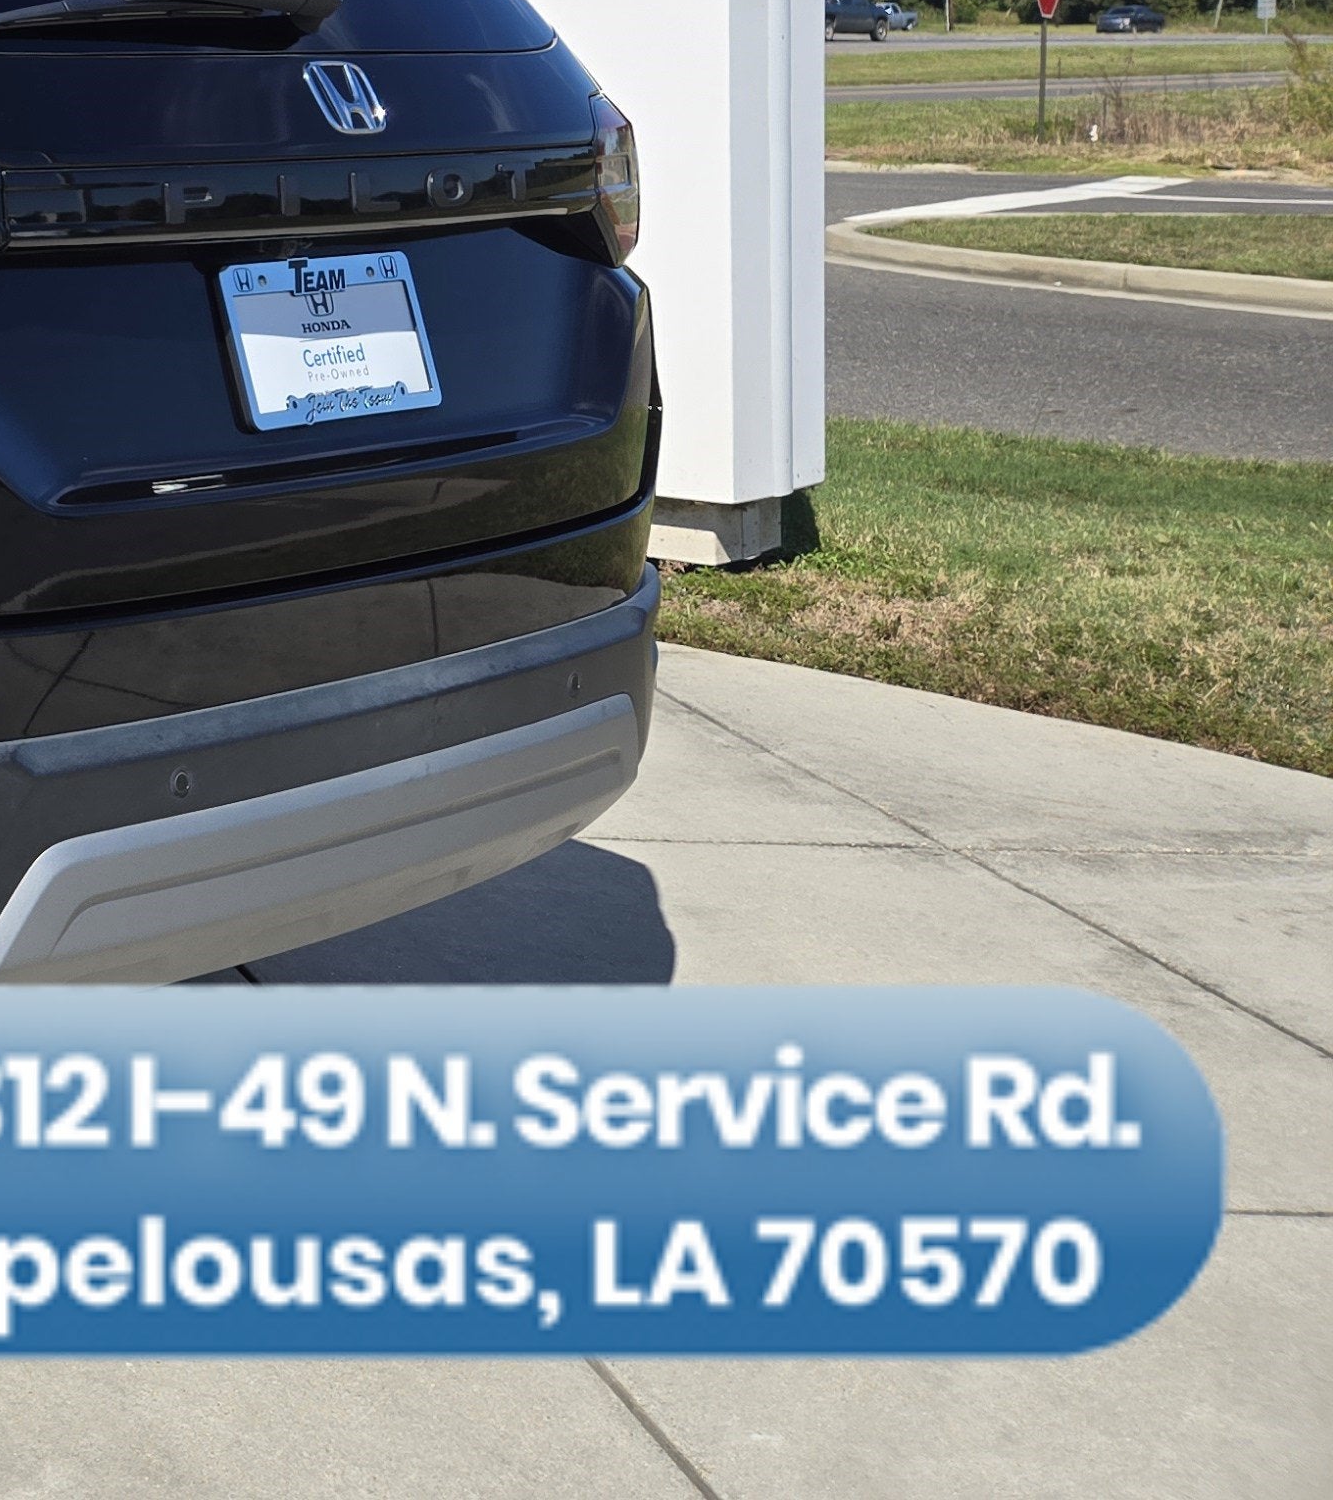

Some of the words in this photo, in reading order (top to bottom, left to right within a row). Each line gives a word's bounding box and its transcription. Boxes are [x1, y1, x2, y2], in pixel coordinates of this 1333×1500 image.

[162, 160, 536, 225] PILOT
[301, 319, 351, 334] HONDA
[302, 342, 367, 368] Certified
[307, 365, 370, 382] Pre-Owned
[305, 393, 335, 423] Join
[334, 390, 359, 412] The
